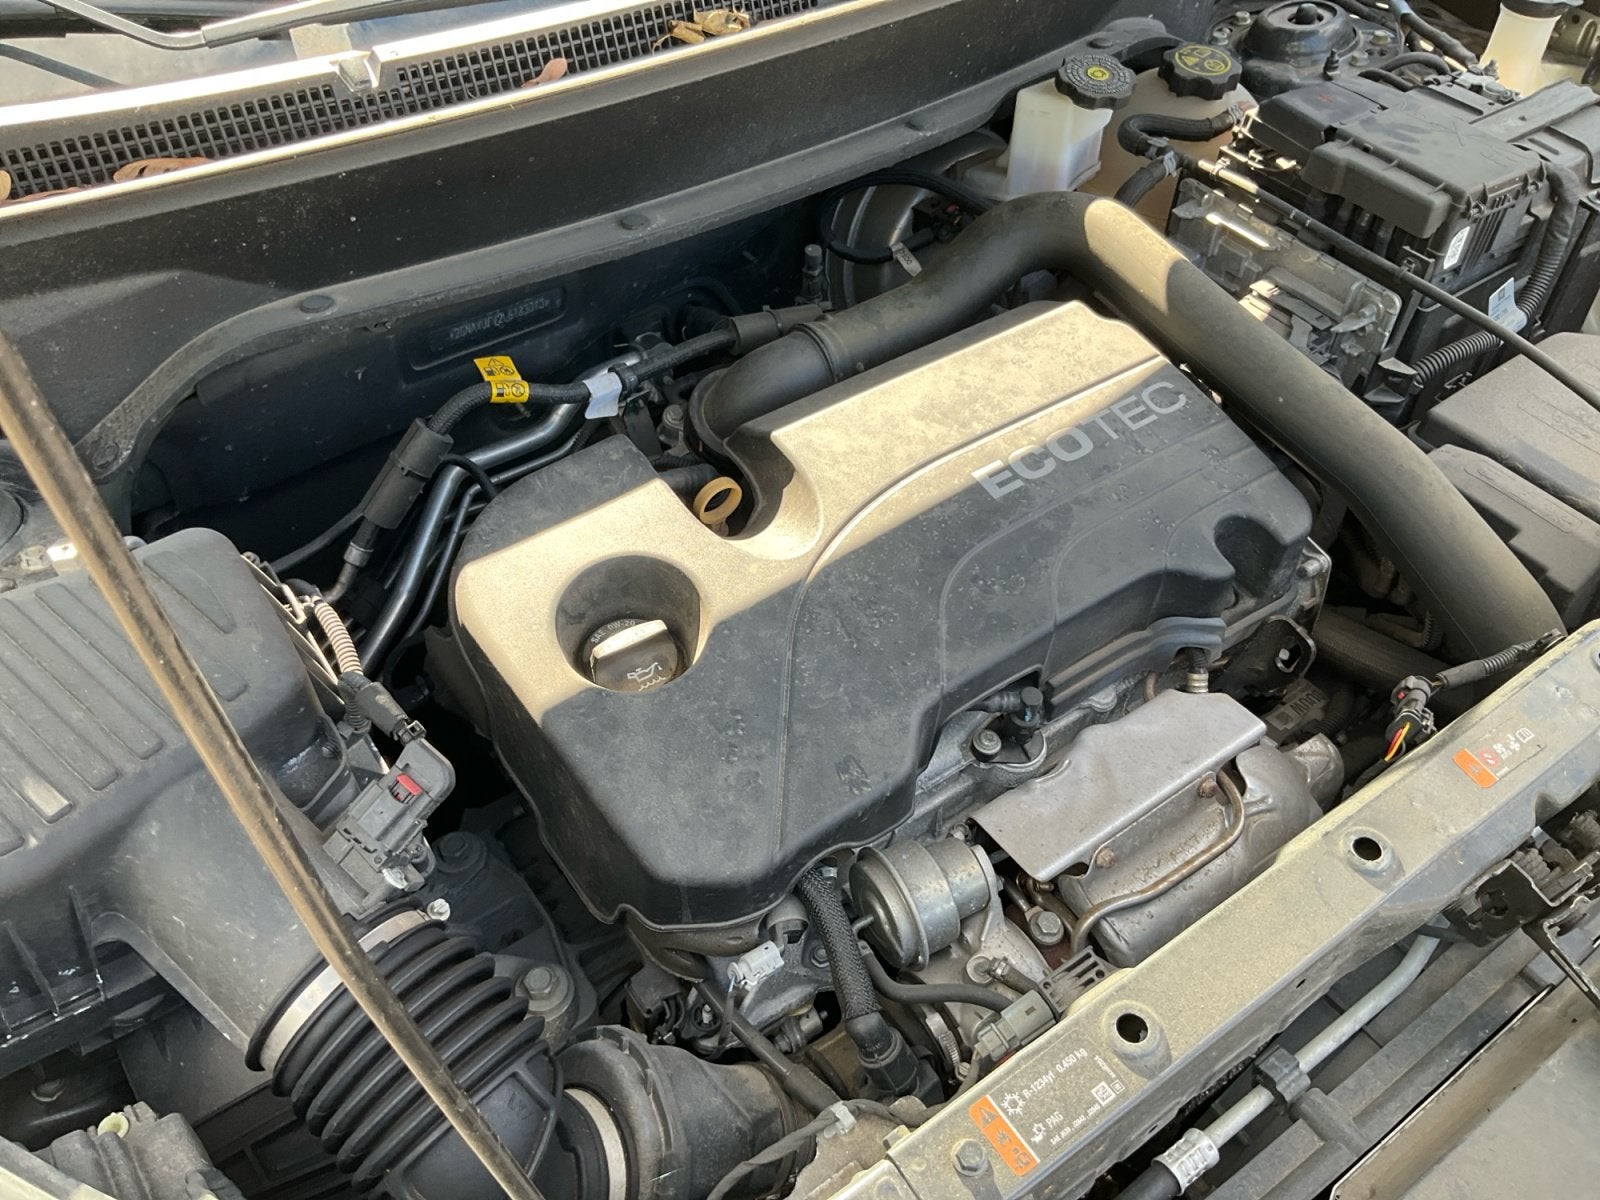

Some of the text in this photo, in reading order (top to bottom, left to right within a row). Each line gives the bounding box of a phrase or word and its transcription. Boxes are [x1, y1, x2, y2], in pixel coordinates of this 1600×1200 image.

[971, 381, 1187, 500] ECOTEC
[591, 620, 636, 643] SAE 0W-20
[1056, 1054, 1078, 1073] 0.450
[1074, 1047, 1089, 1060] kg
[1045, 1111, 1064, 1129] PAG
